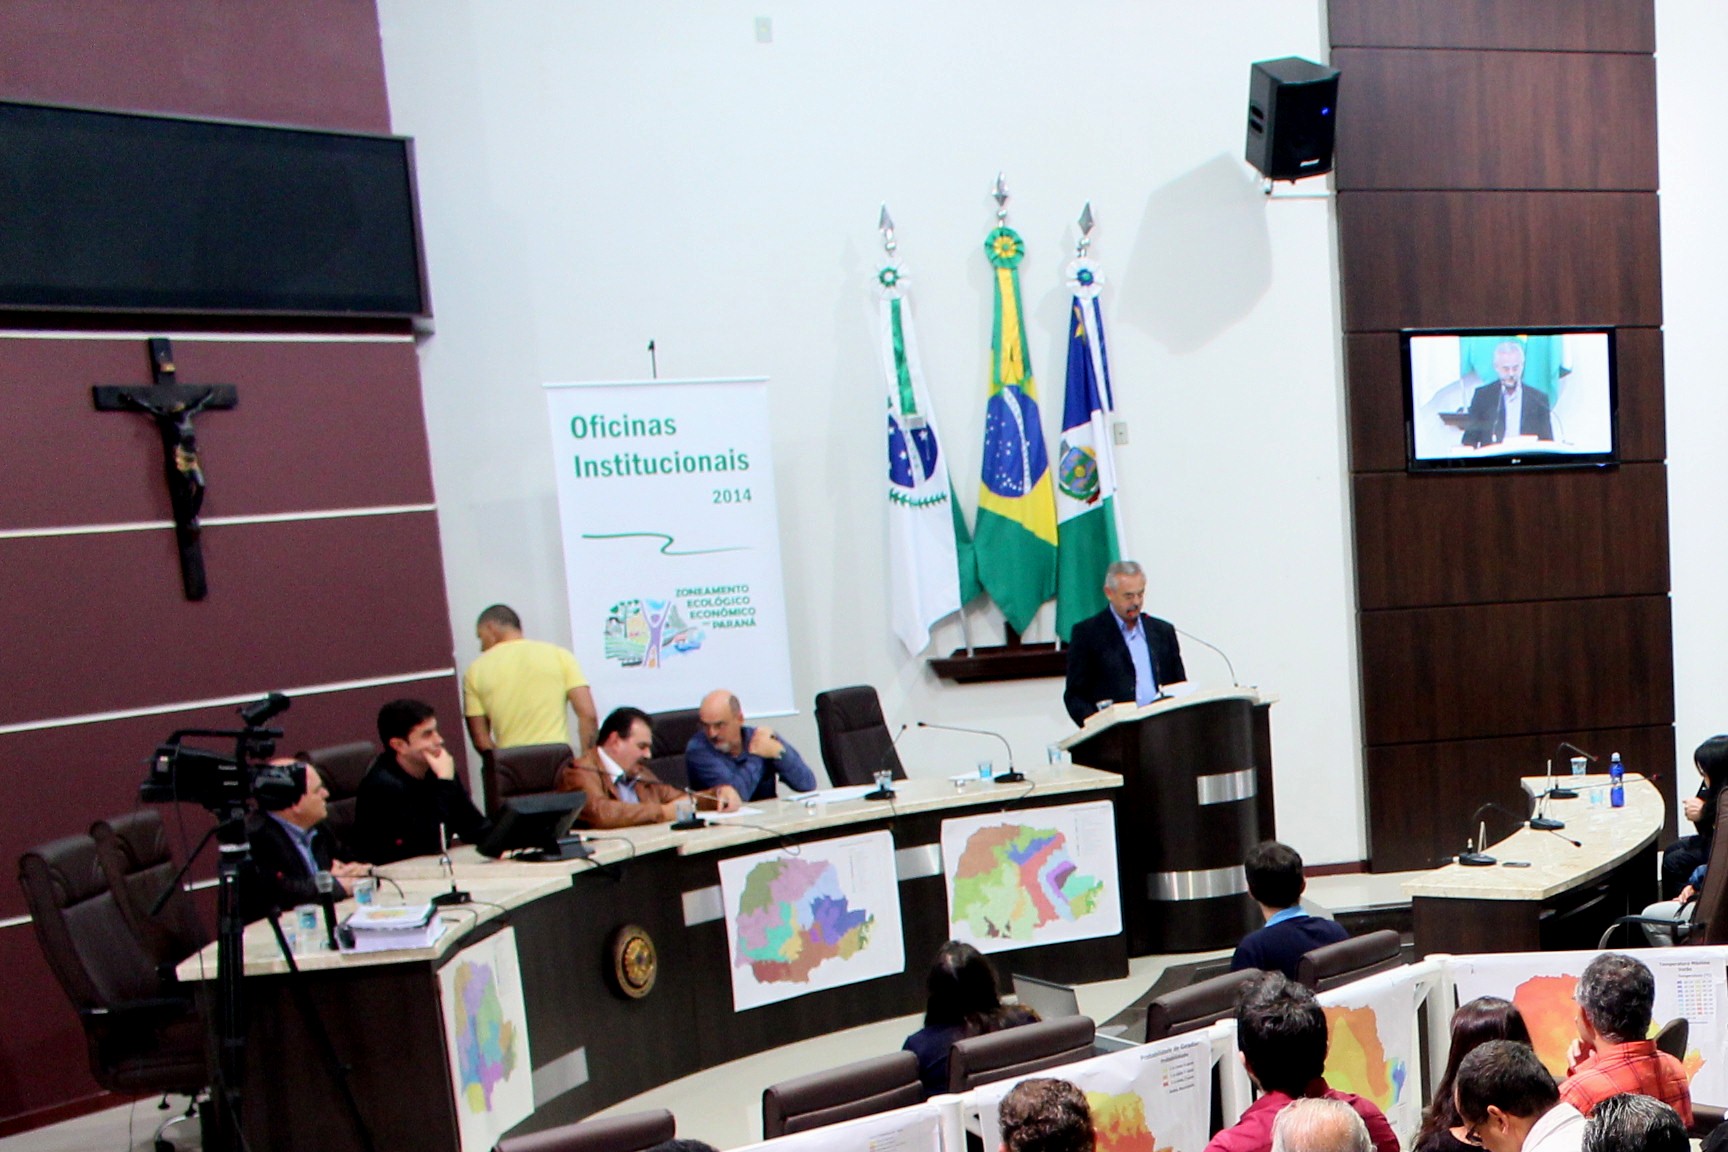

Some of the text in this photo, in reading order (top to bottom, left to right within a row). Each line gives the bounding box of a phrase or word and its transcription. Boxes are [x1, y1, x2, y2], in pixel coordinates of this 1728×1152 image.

[570, 414, 678, 439] Oficinas
[573, 448, 751, 478] Institucionais
[712, 488, 752, 504] 2014
[675, 584, 750, 598] ZONEAMENTO
[687, 596, 751, 608] ECOLÓGICO
[690, 607, 757, 619] ECONÔMICO
[712, 618, 757, 629] PARANÁ
